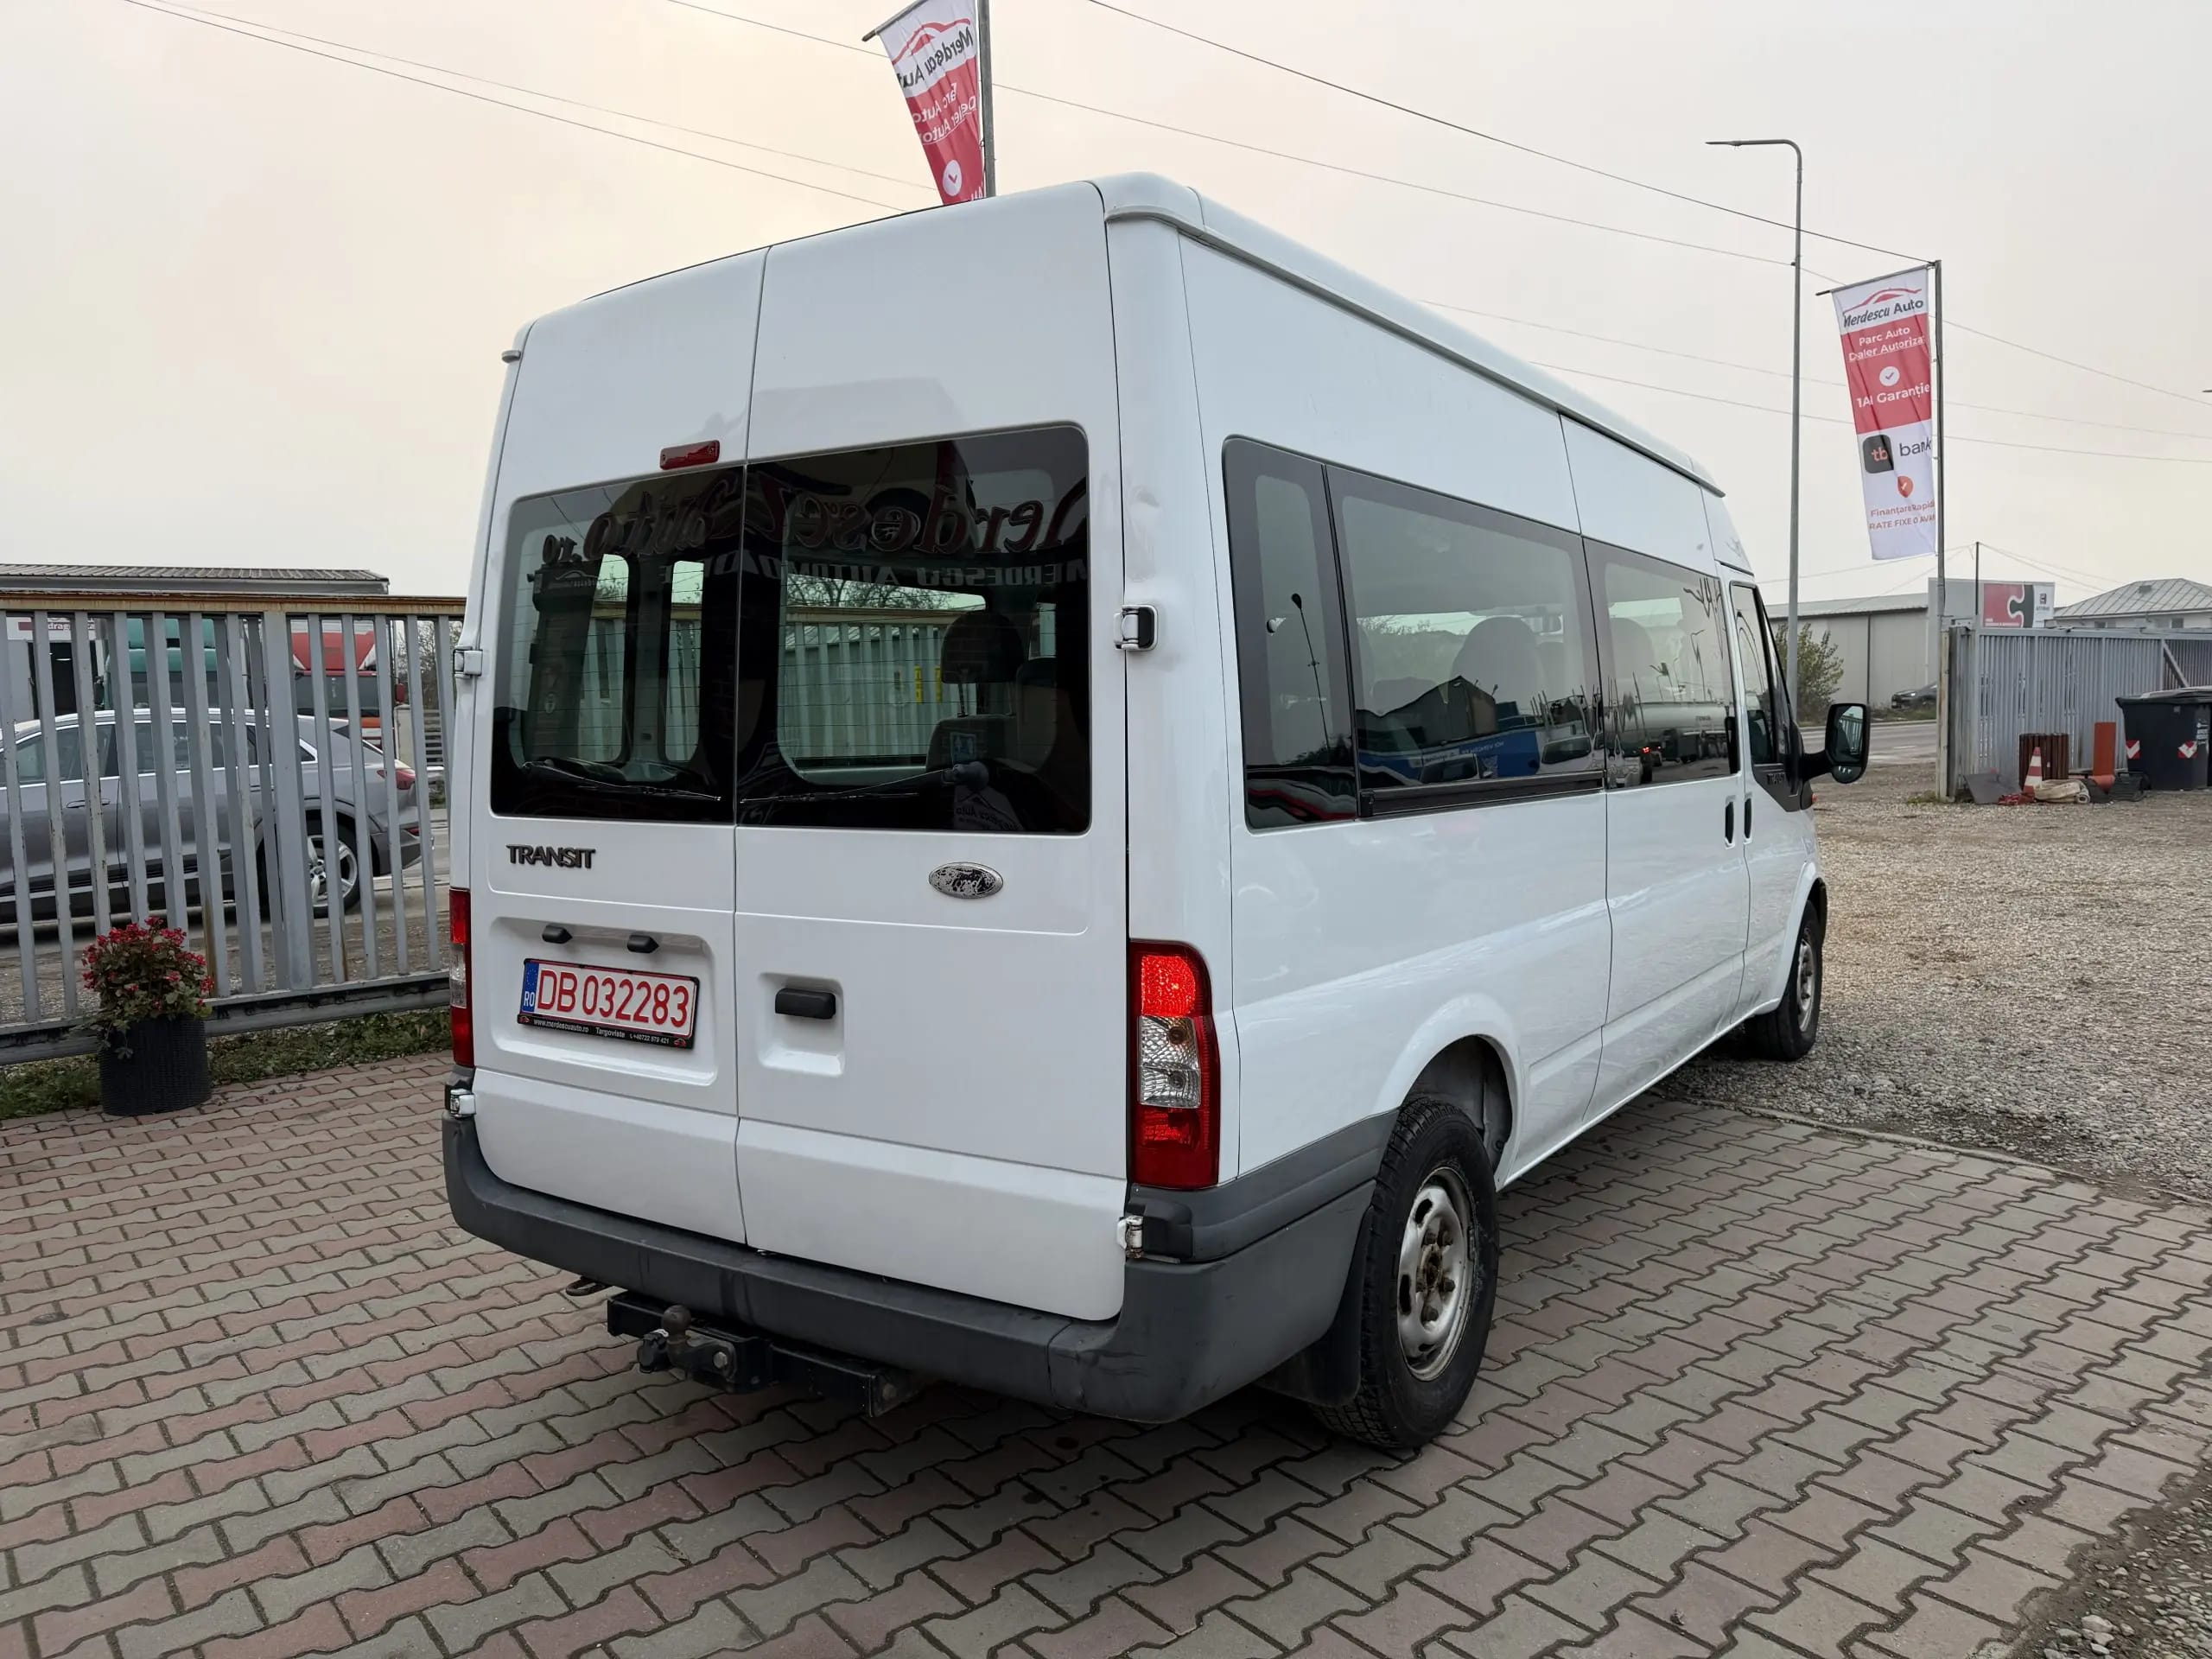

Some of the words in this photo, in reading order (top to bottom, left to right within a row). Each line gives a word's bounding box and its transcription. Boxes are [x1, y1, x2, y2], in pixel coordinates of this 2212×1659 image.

[1893, 299, 1923, 315] Auto
[1859, 334, 1882, 346] Parc
[1885, 327, 1910, 340] Auto
[1895, 518, 1912, 526] FIXE
[505, 843, 596, 869] TRANSIT
[524, 990, 536, 1007] RO
[537, 969, 578, 1013] DB
[582, 974, 690, 1028] 032283
